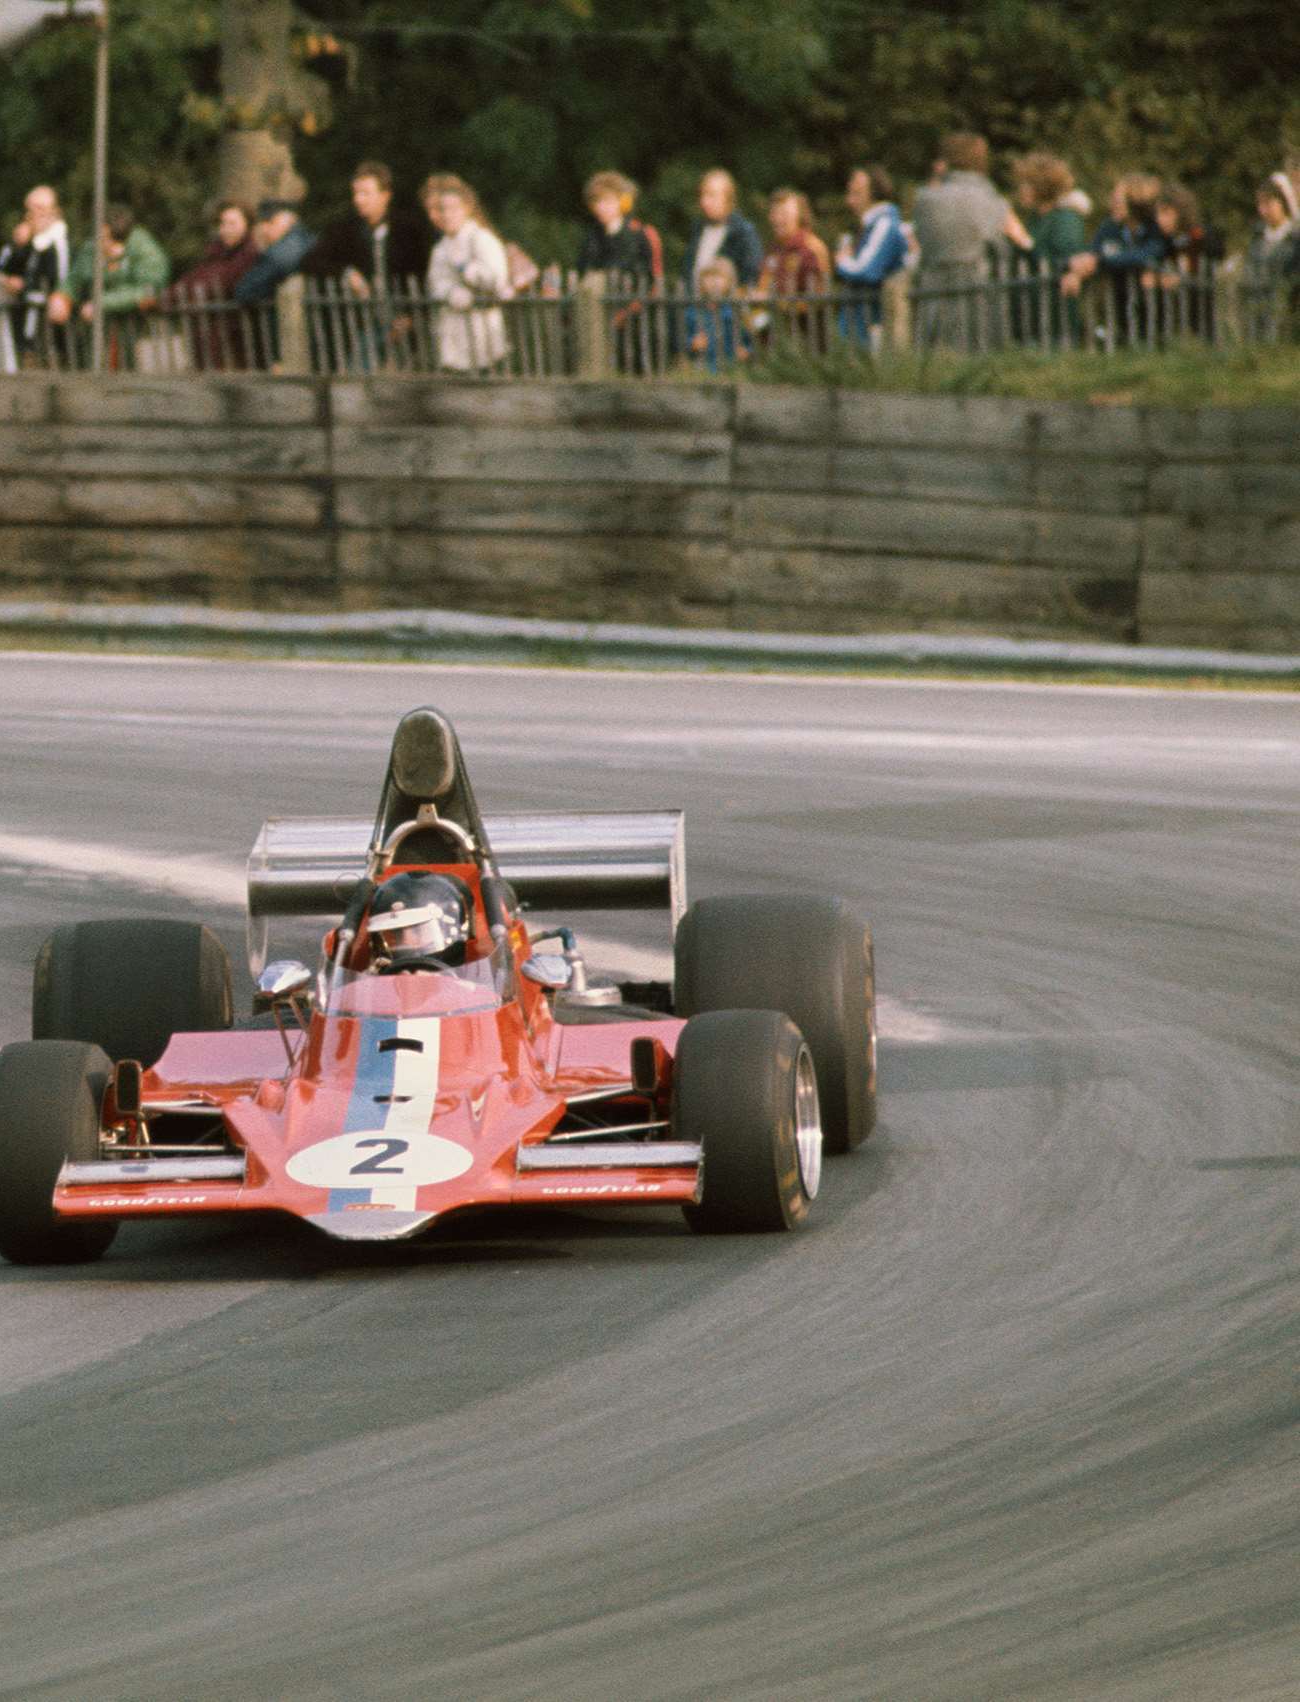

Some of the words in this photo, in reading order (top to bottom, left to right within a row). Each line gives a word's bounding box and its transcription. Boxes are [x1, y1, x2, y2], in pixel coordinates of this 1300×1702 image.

[349, 1138, 409, 1176] 2
[541, 1184, 661, 1194] GOODYEAR
[88, 1195, 207, 1207] GOODYEAR
